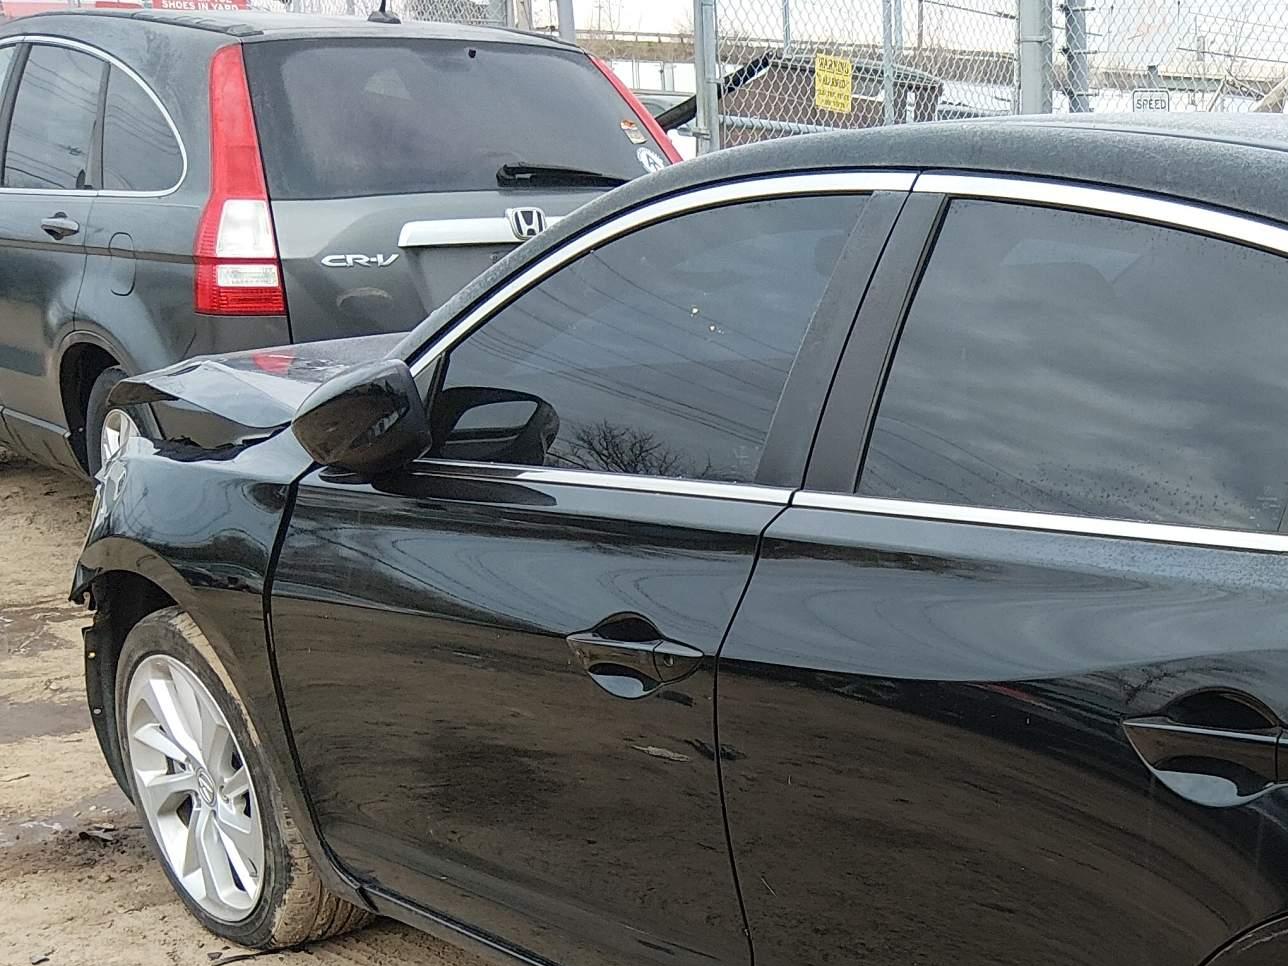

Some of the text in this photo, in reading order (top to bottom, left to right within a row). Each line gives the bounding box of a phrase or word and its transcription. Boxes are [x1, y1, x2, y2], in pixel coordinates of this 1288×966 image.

[161, 1, 239, 11] SHOES IN YARD
[1136, 98, 1167, 110] SPEED
[320, 253, 399, 267] CR-V
